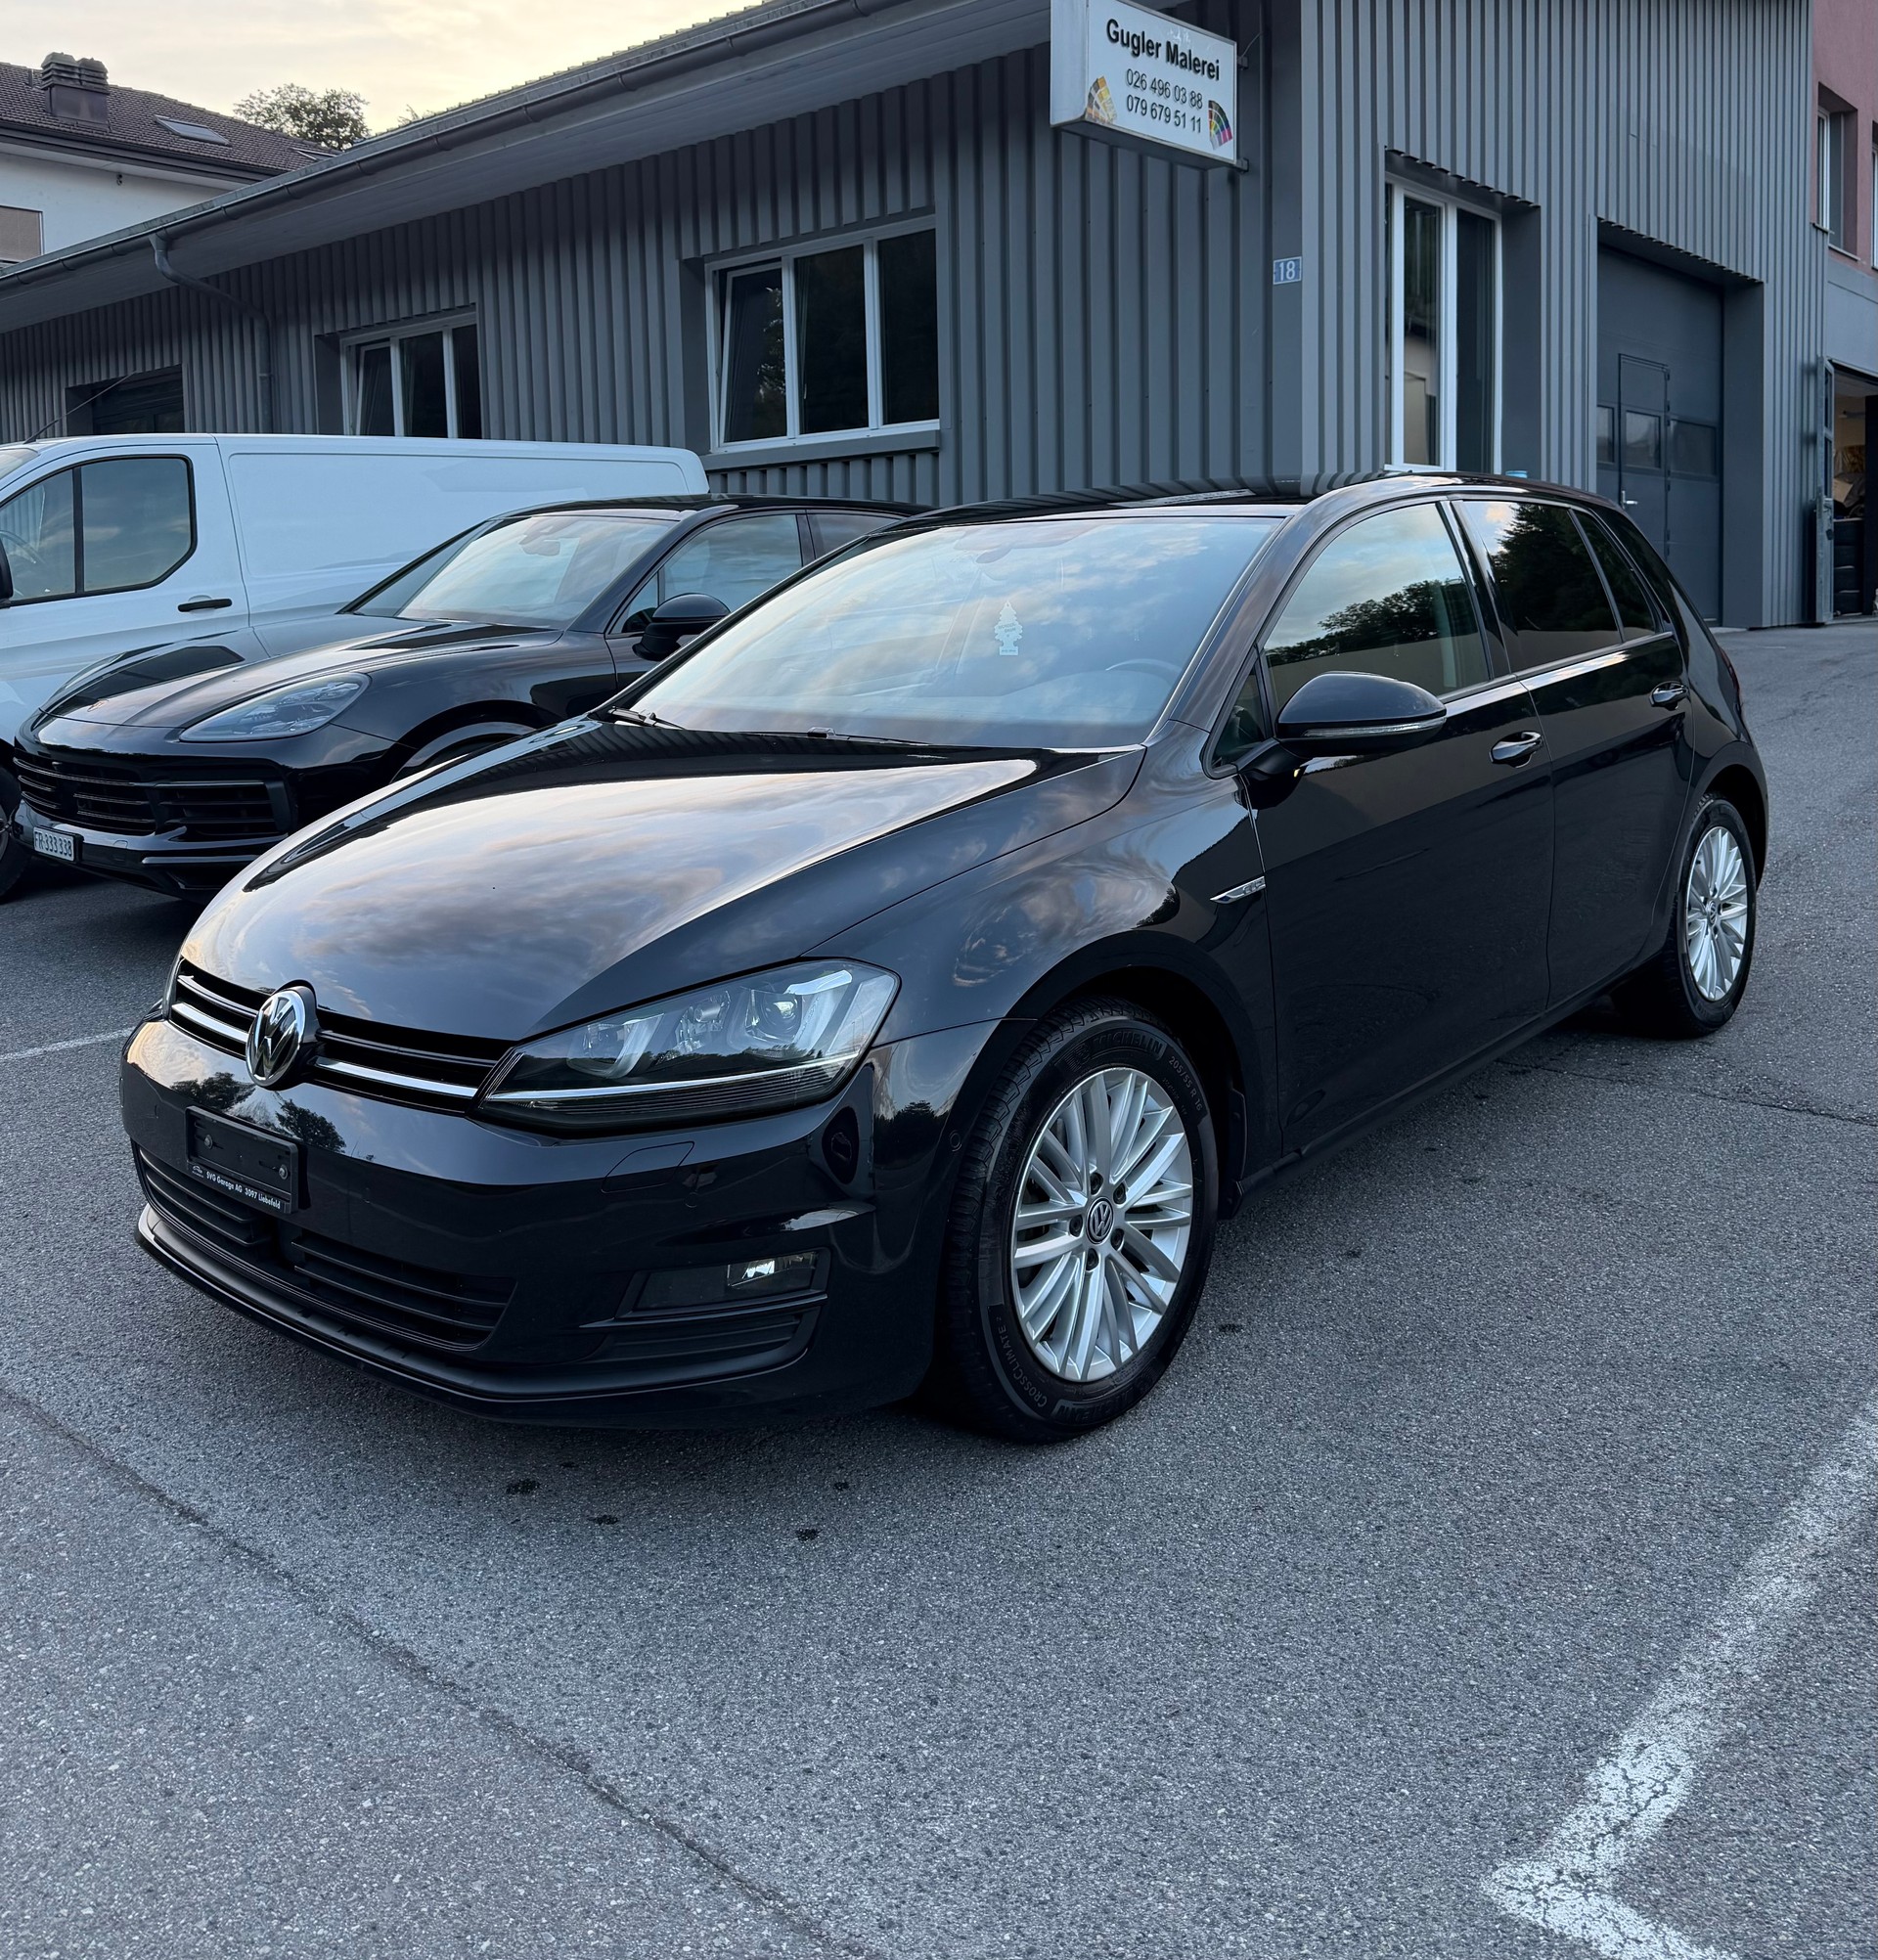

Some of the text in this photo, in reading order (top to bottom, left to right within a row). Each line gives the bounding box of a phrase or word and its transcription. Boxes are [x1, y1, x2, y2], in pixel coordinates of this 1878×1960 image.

[1106, 19, 1220, 80] Gugler Malerei
[1126, 68, 1203, 109] 026 496 03 88
[1127, 95, 1201, 133] 079 679 51 11
[1279, 260, 1295, 281] 18
[1168, 1055, 1203, 1111] 205/55 R 16
[206, 1171, 216, 1181] SVG
[216, 1176, 235, 1190] Garage
[235, 1183, 243, 1193] AG
[997, 1325, 1049, 1408] CROSSCLIMATE
